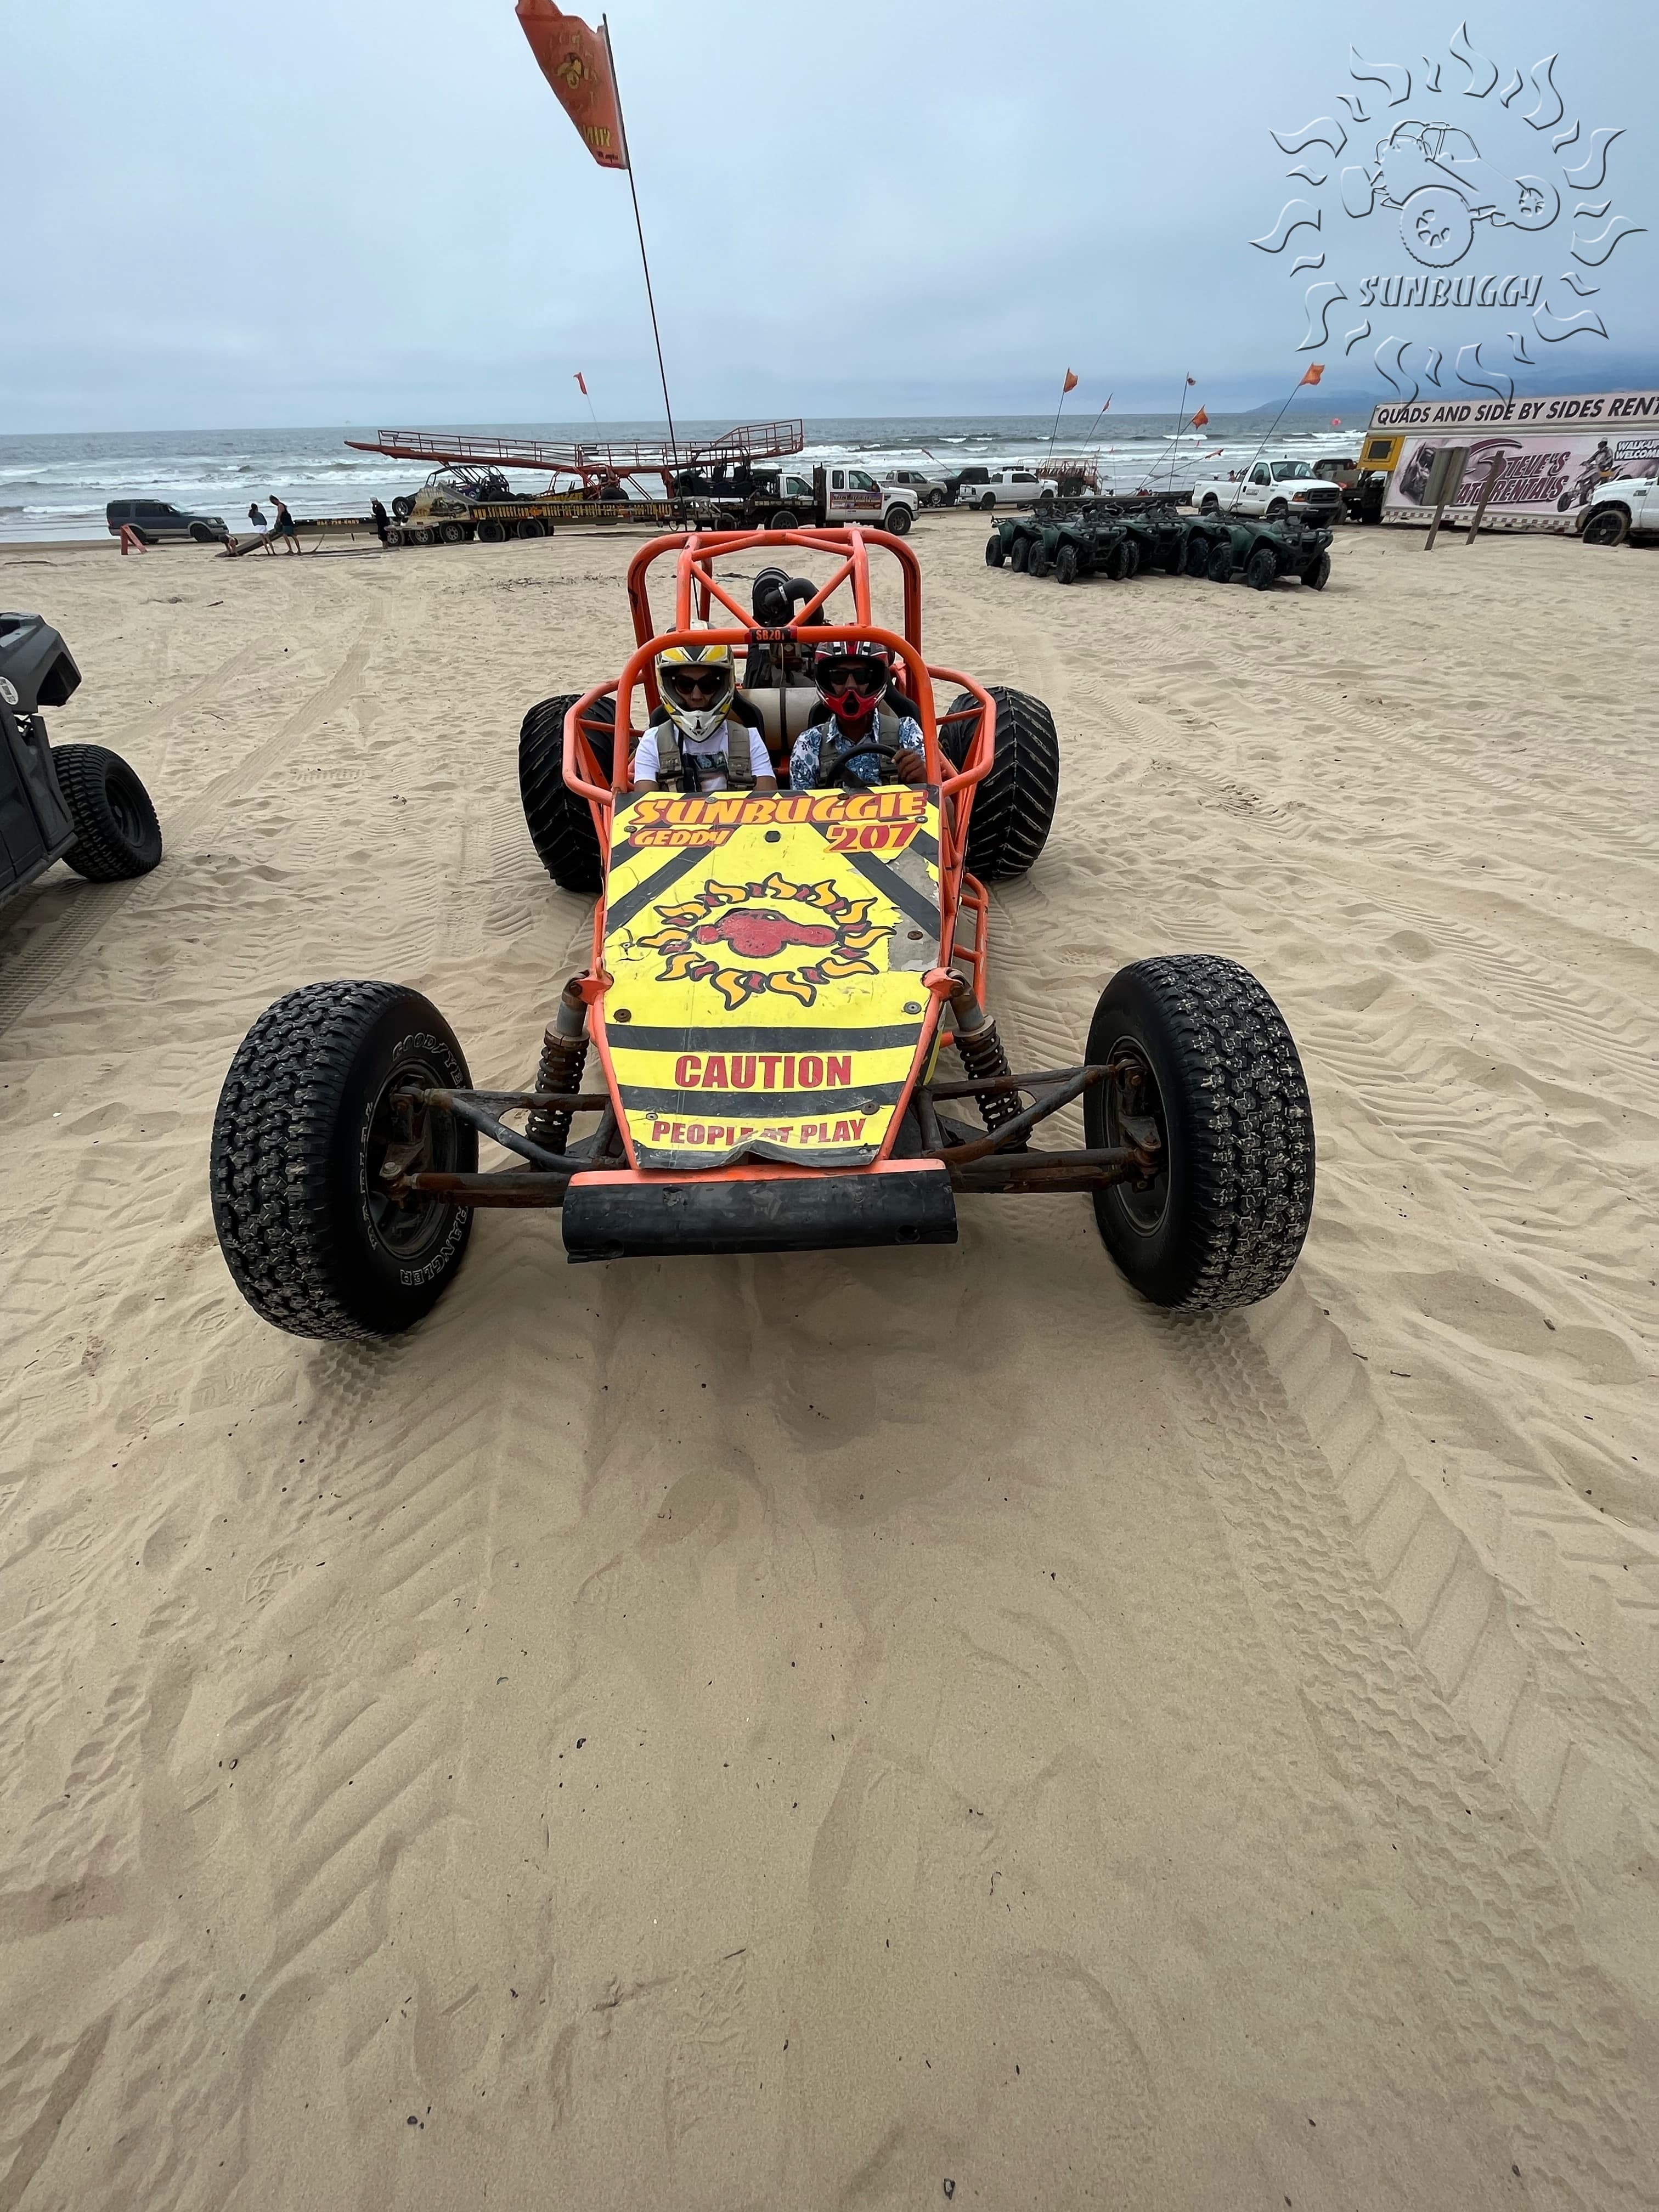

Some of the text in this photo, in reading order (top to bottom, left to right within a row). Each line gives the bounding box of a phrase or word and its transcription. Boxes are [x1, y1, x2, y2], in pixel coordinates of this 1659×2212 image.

[1378, 407, 1430, 425] QUADS
[1432, 404, 1472, 422] AND
[1474, 403, 1516, 421] SIDE
[1518, 401, 1546, 420] BY
[1546, 399, 1605, 418] SIDES
[1487, 476, 1570, 503] RENTALS
[629, 791, 928, 824] SUNBUGGIE
[632, 822, 920, 851] GEDDY 207
[392, 1032, 466, 1089] GOODYE
[675, 1056, 851, 1089] CAUTION
[799, 1118, 867, 1144] PLAY
[400, 1206, 469, 1285] RANGLER
